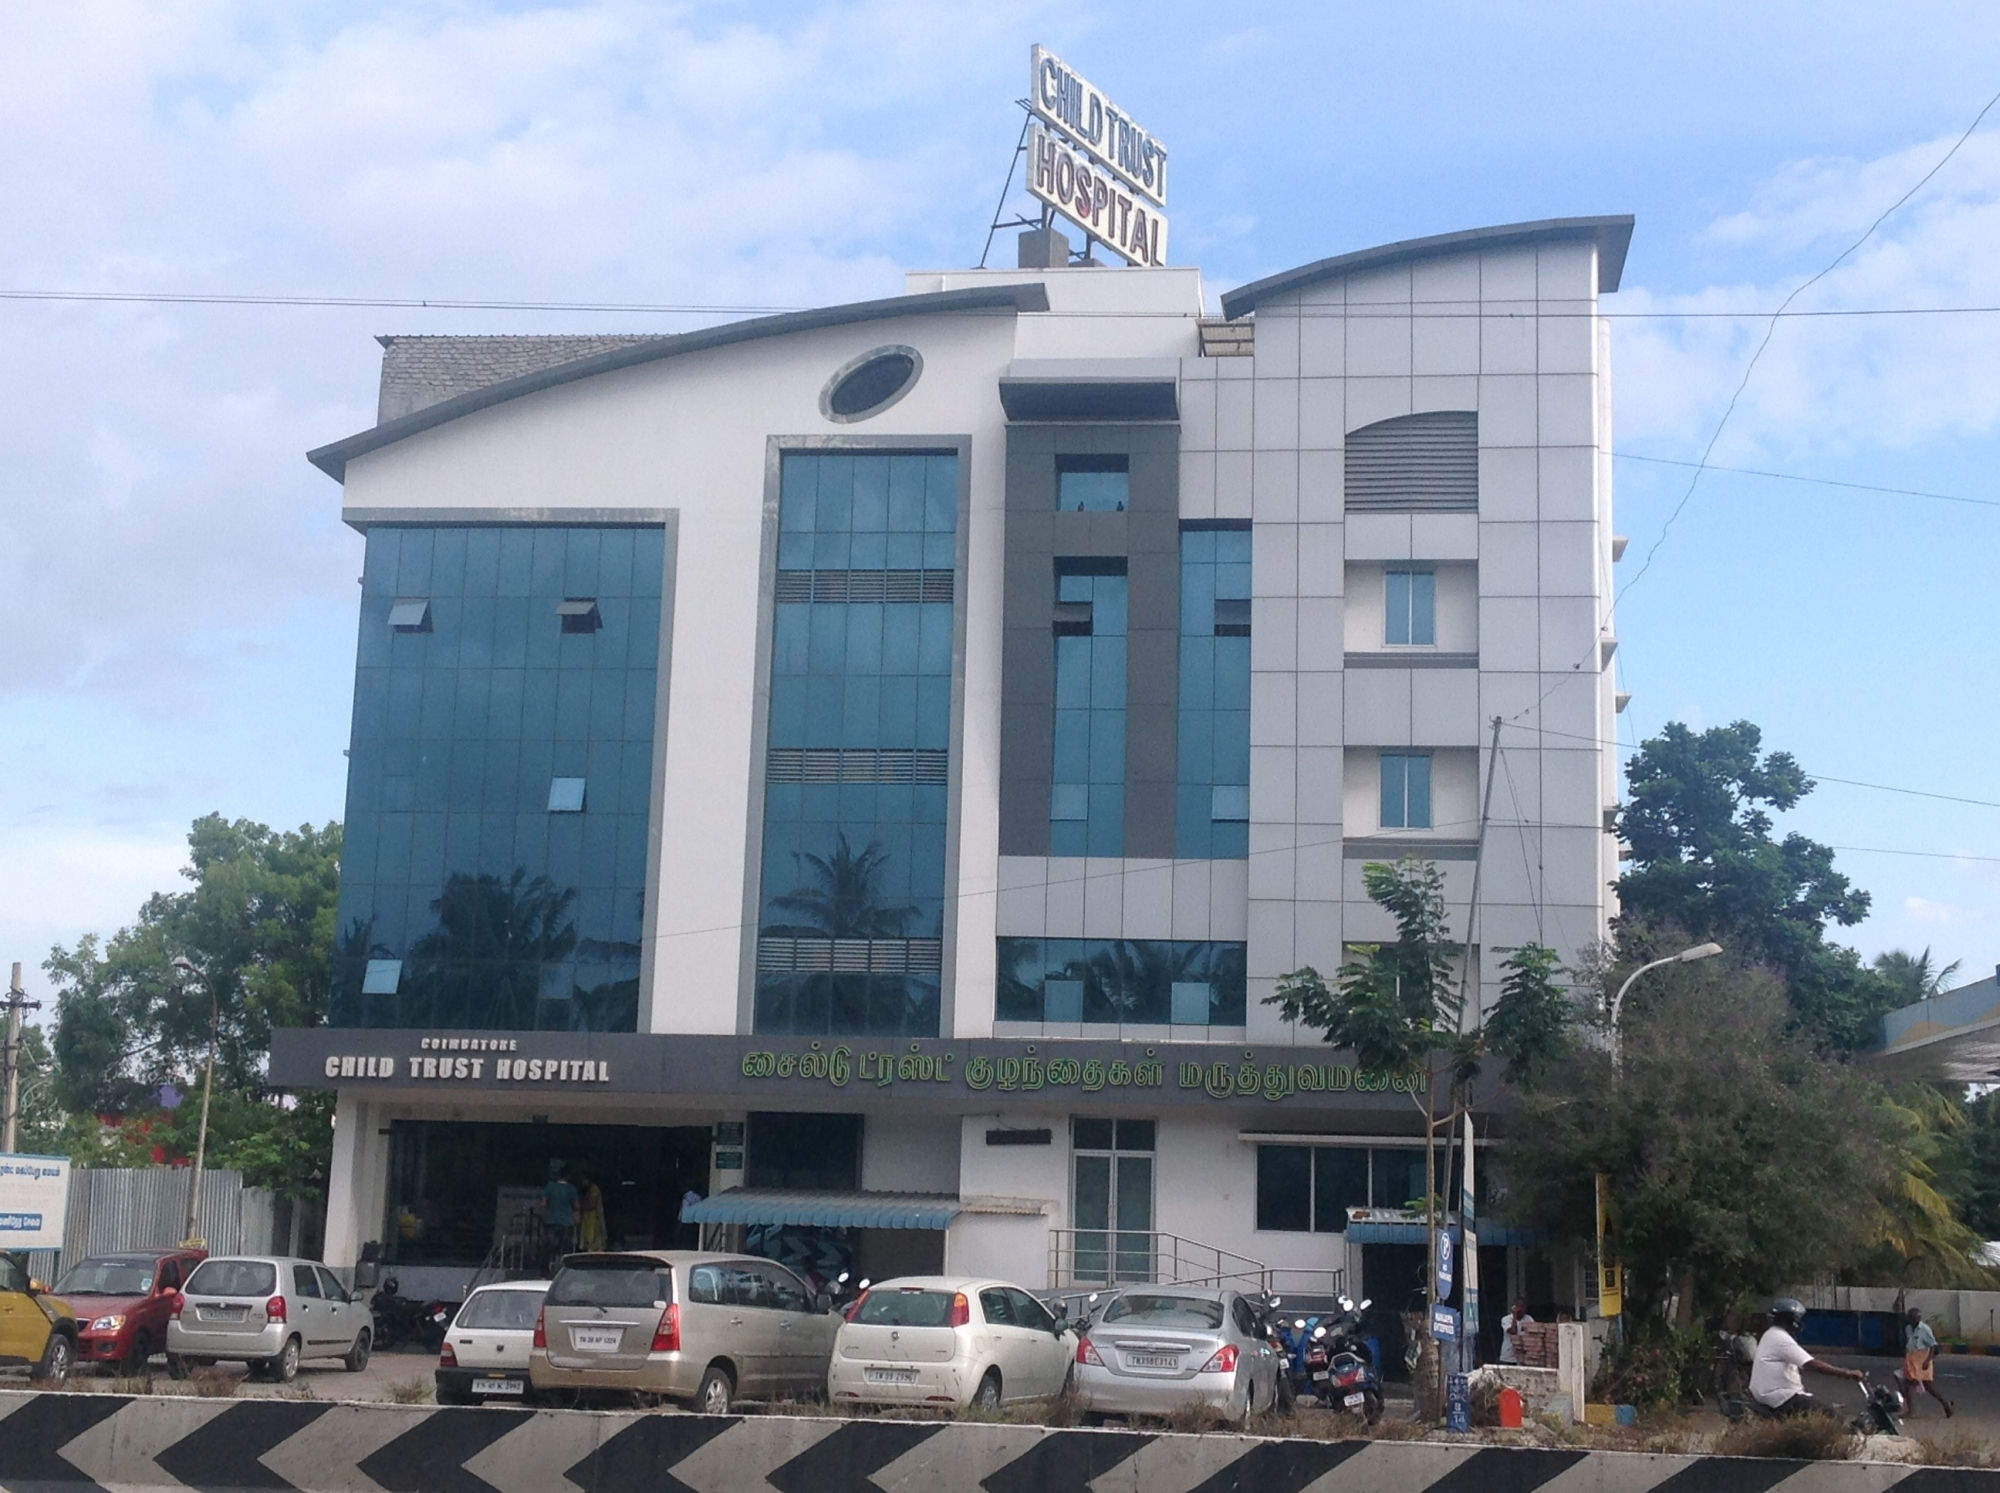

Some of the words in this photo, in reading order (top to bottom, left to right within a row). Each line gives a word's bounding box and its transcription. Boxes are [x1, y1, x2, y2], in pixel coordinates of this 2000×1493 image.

[1040, 57, 1103, 146] CHILD
[1105, 106, 1167, 198] TRUST
[1037, 134, 1166, 267] HOSPITAL
[421, 1037, 518, 1051] COIMBATORE
[965, 1044, 1163, 1090] குழந்தைகள்
[324, 1056, 395, 1078] CHILD
[409, 1057, 484, 1080] TRUST
[496, 1059, 610, 1083] HOSPITAL
